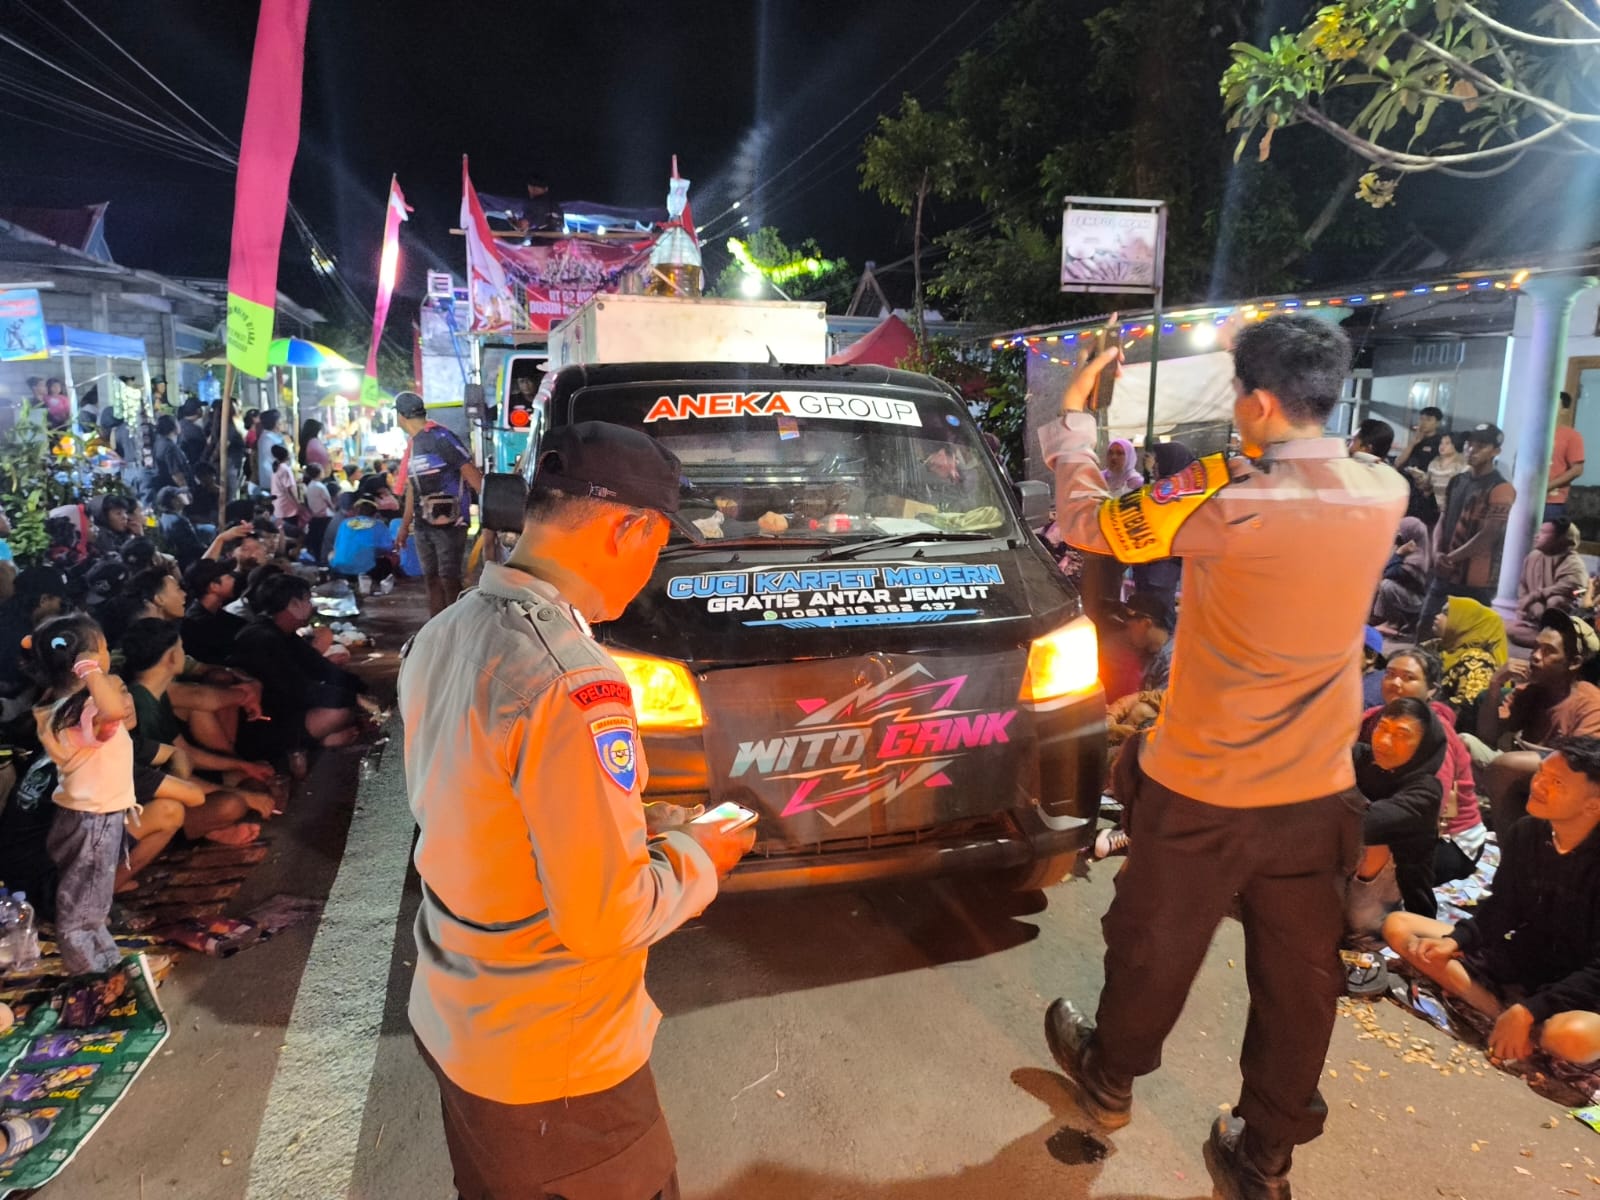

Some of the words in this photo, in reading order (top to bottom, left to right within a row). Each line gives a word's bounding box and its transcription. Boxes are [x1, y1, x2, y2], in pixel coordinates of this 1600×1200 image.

[645, 393, 792, 421] ANEKA
[799, 394, 914, 424] GROUP
[667, 573, 749, 599] CUCI
[753, 567, 879, 595] KARPET
[882, 564, 1005, 588] MODERN
[707, 593, 800, 613] GRATIS
[809, 589, 891, 606] ANTAR
[899, 586, 989, 602] JEMPUT
[920, 602, 956, 611] 437
[728, 727, 873, 778] WITO
[876, 709, 1018, 759] GANK
[82, 1043, 117, 1054] Taro
[49, 1088, 81, 1099] Taro
